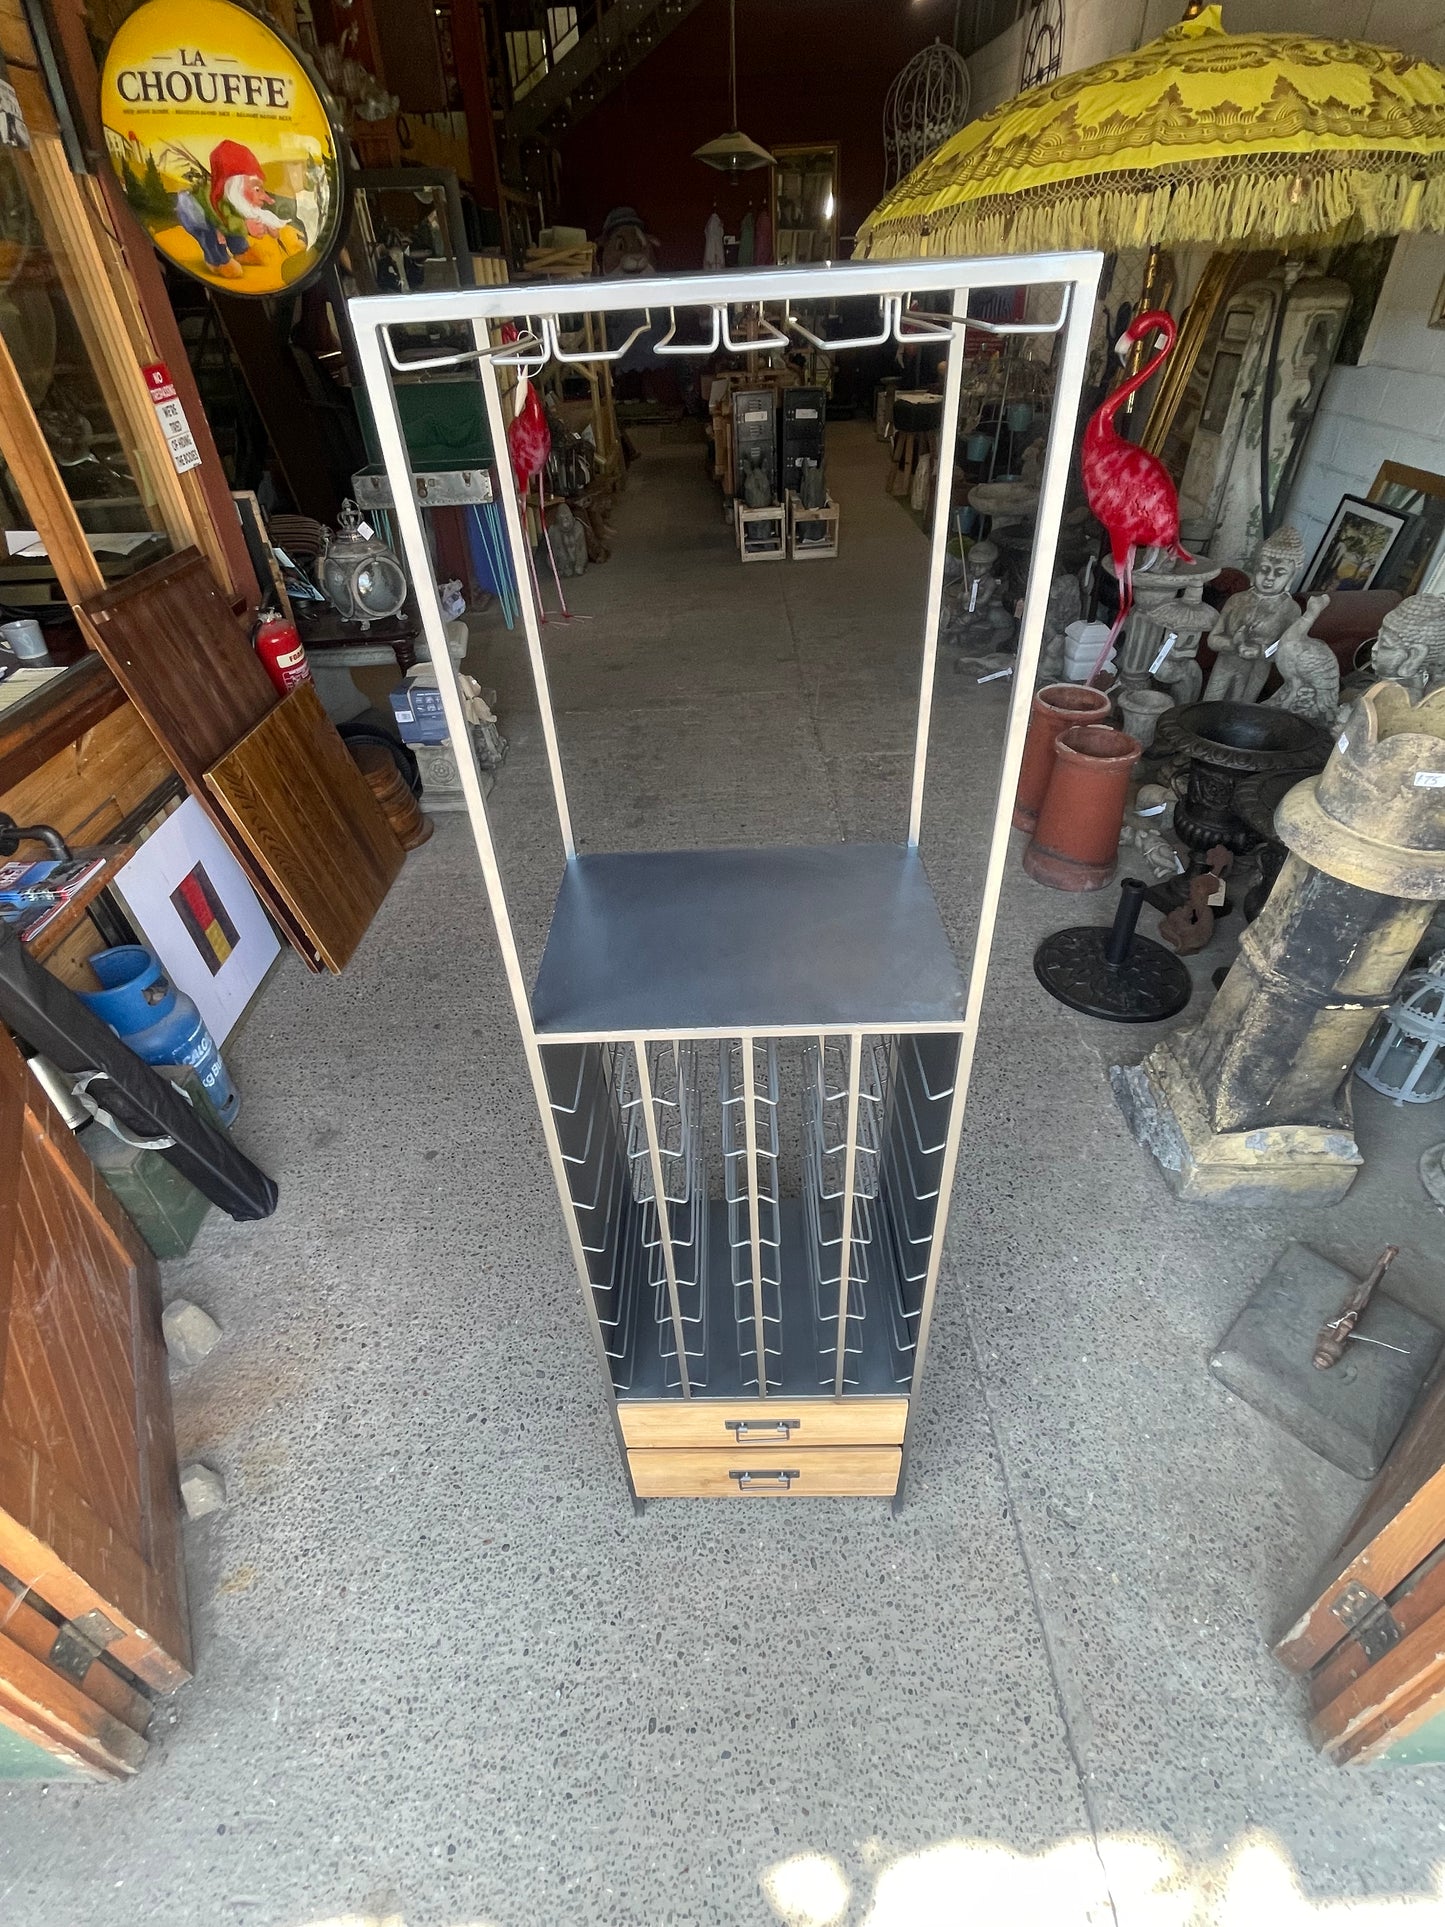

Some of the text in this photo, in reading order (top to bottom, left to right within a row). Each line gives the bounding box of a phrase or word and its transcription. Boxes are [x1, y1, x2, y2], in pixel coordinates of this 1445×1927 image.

[179, 48, 206, 67] LA
[117, 70, 289, 108] CHOUFFE
[152, 371, 163, 385] NO
